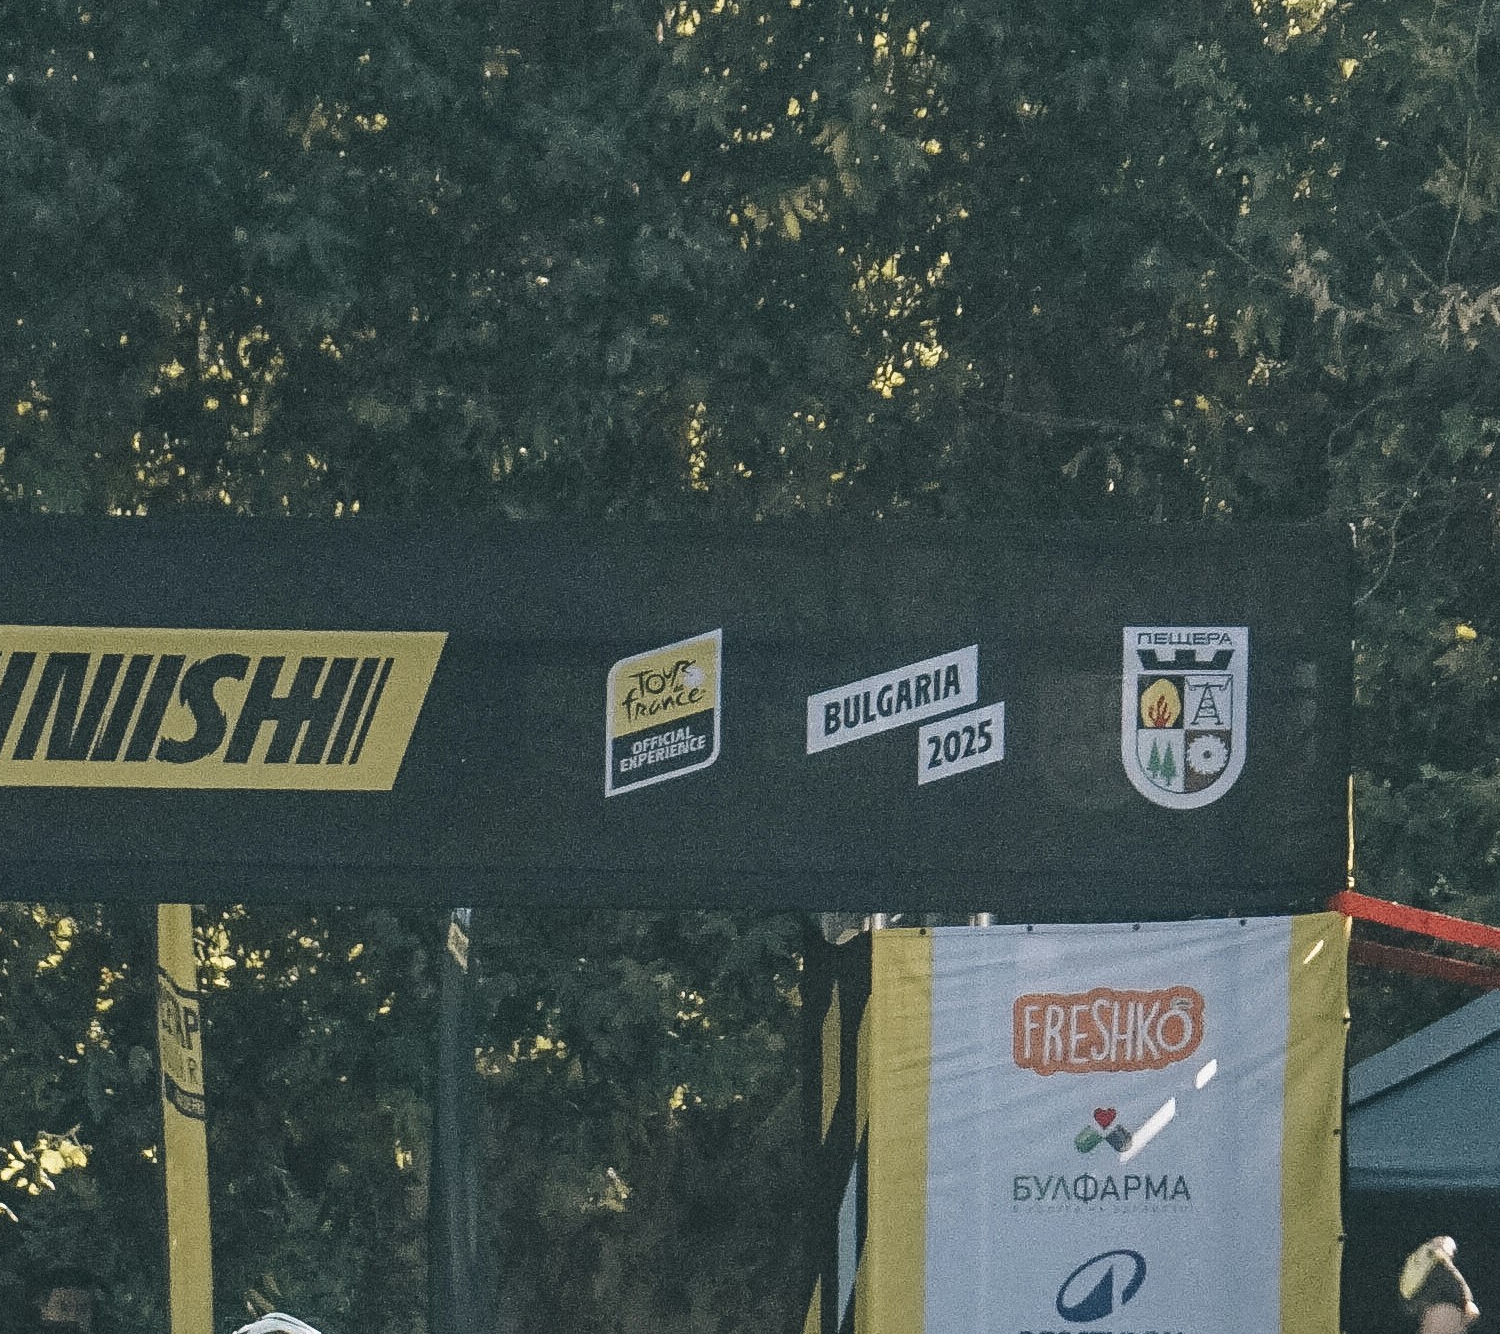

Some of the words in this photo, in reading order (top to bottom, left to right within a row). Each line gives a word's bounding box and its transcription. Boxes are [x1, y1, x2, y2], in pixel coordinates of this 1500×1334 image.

[1136, 631, 1234, 646] ПЕЩЕРА
[822, 662, 962, 736] BULGARIA
[619, 734, 707, 773] EXPERIENCE
[631, 726, 696, 755] OFFICIAL
[926, 720, 994, 769] 2025
[1013, 1172, 1191, 1205] БУЛФАРМА
